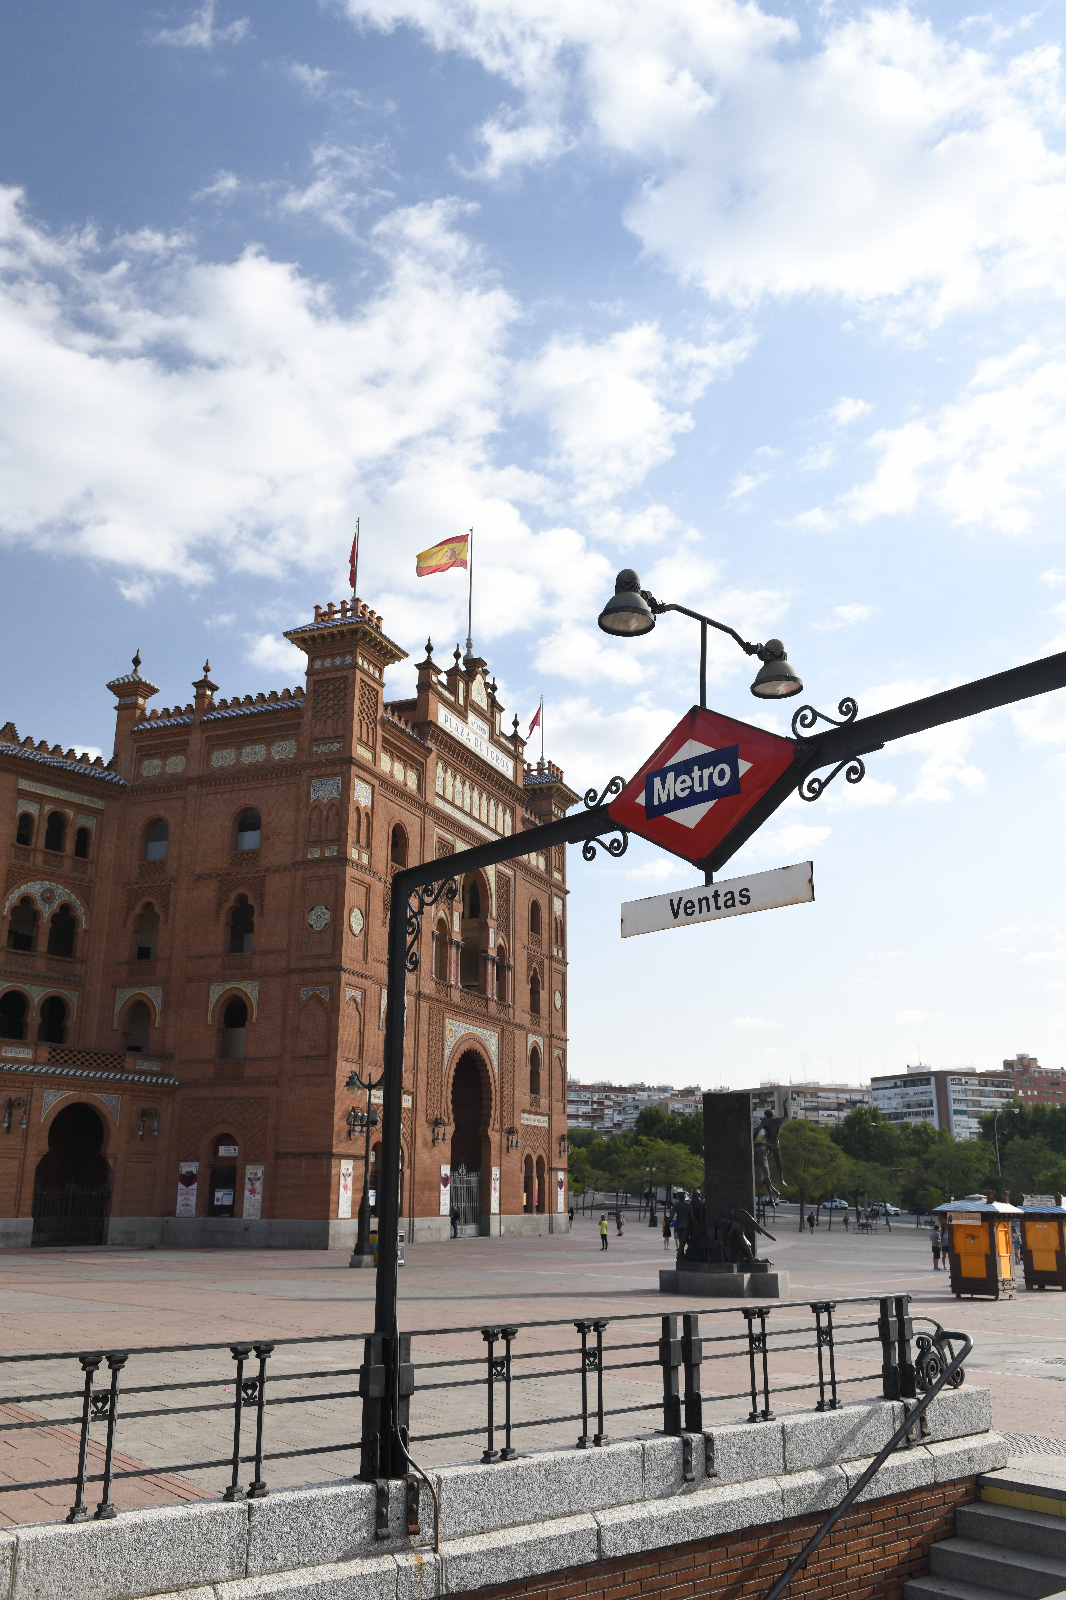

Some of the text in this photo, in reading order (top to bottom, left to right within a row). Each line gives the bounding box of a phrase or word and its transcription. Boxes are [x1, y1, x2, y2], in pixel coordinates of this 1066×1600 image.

[444, 714, 471, 743] PLAZA
[475, 737, 483, 752] DE
[485, 745, 509, 772] TOROS
[653, 762, 731, 806] Metro
[669, 887, 751, 919] Ventas
